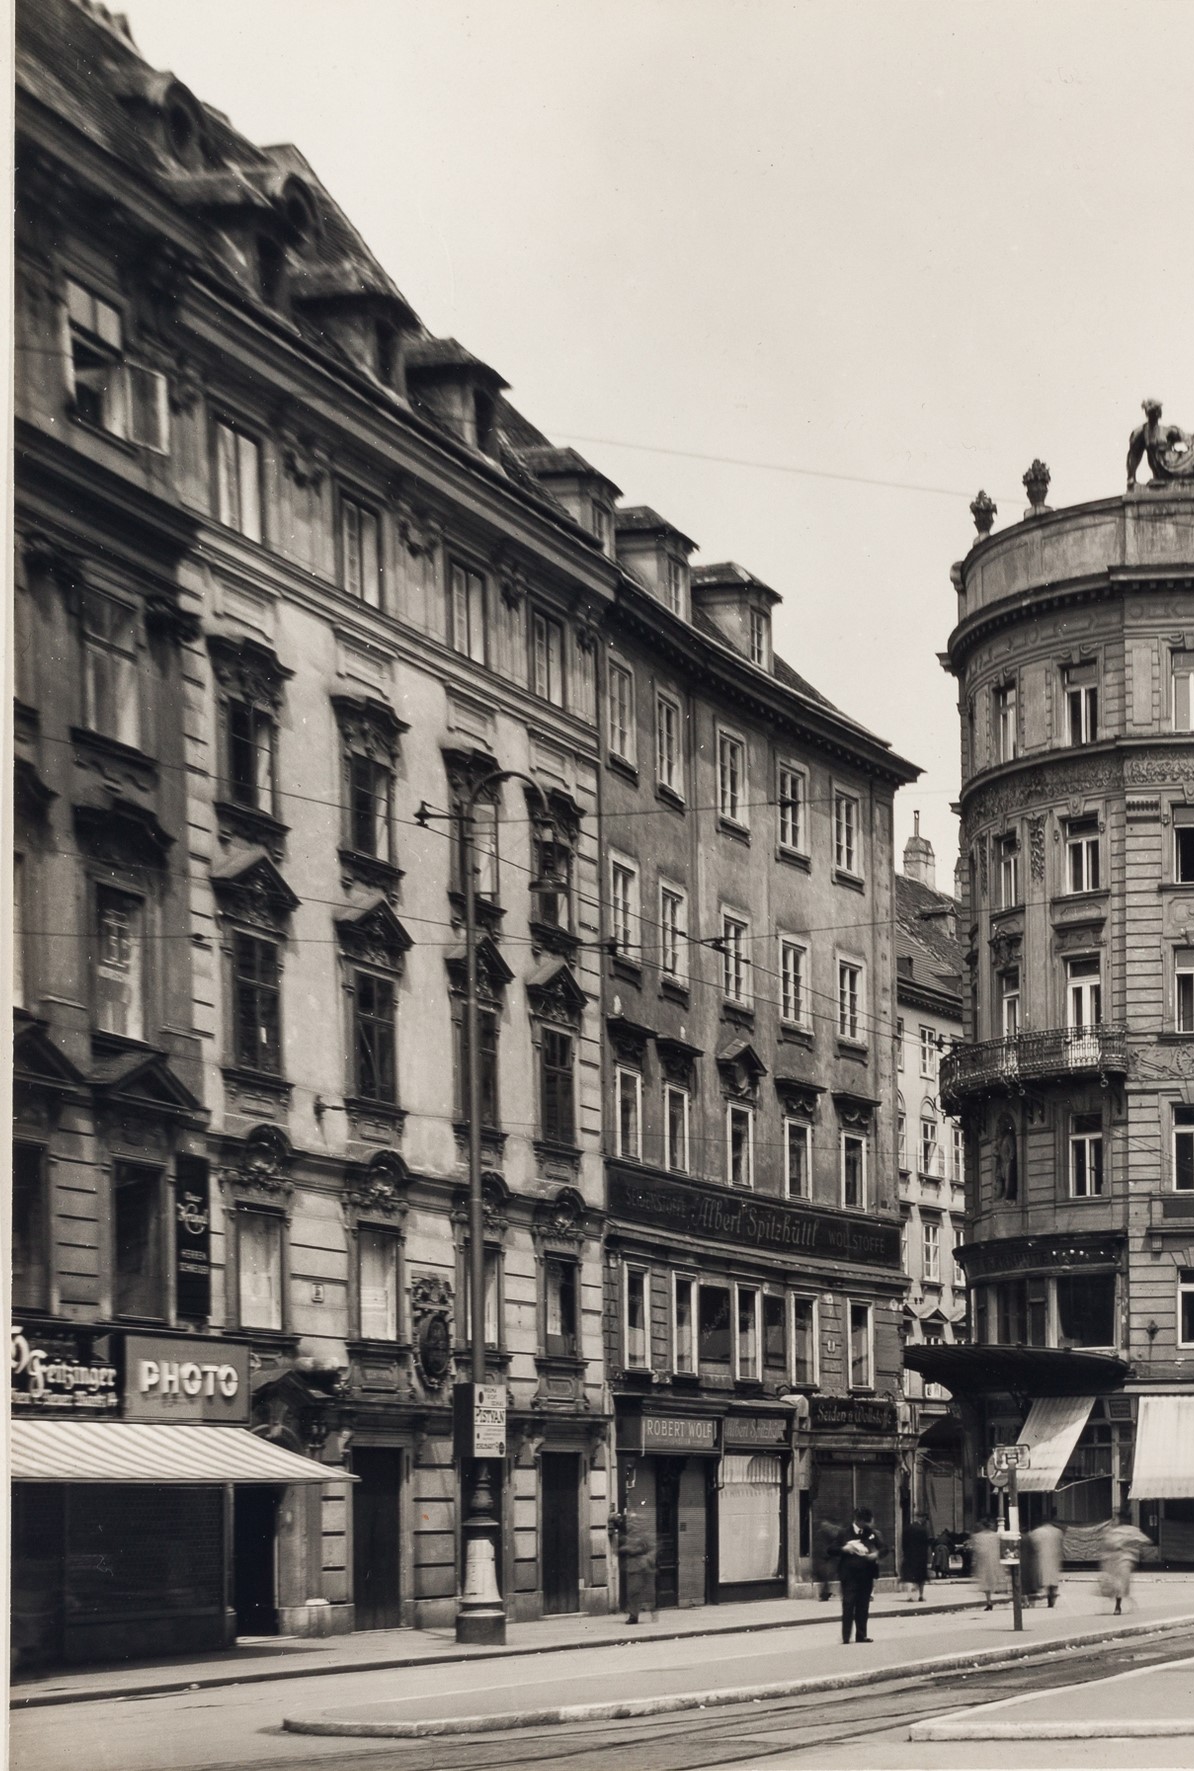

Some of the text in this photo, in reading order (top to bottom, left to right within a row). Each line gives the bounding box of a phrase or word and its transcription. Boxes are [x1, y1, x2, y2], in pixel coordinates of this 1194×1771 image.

[139, 1359, 239, 1397] PHOTO
[647, 1419, 713, 1439] ROBERT WOLF
